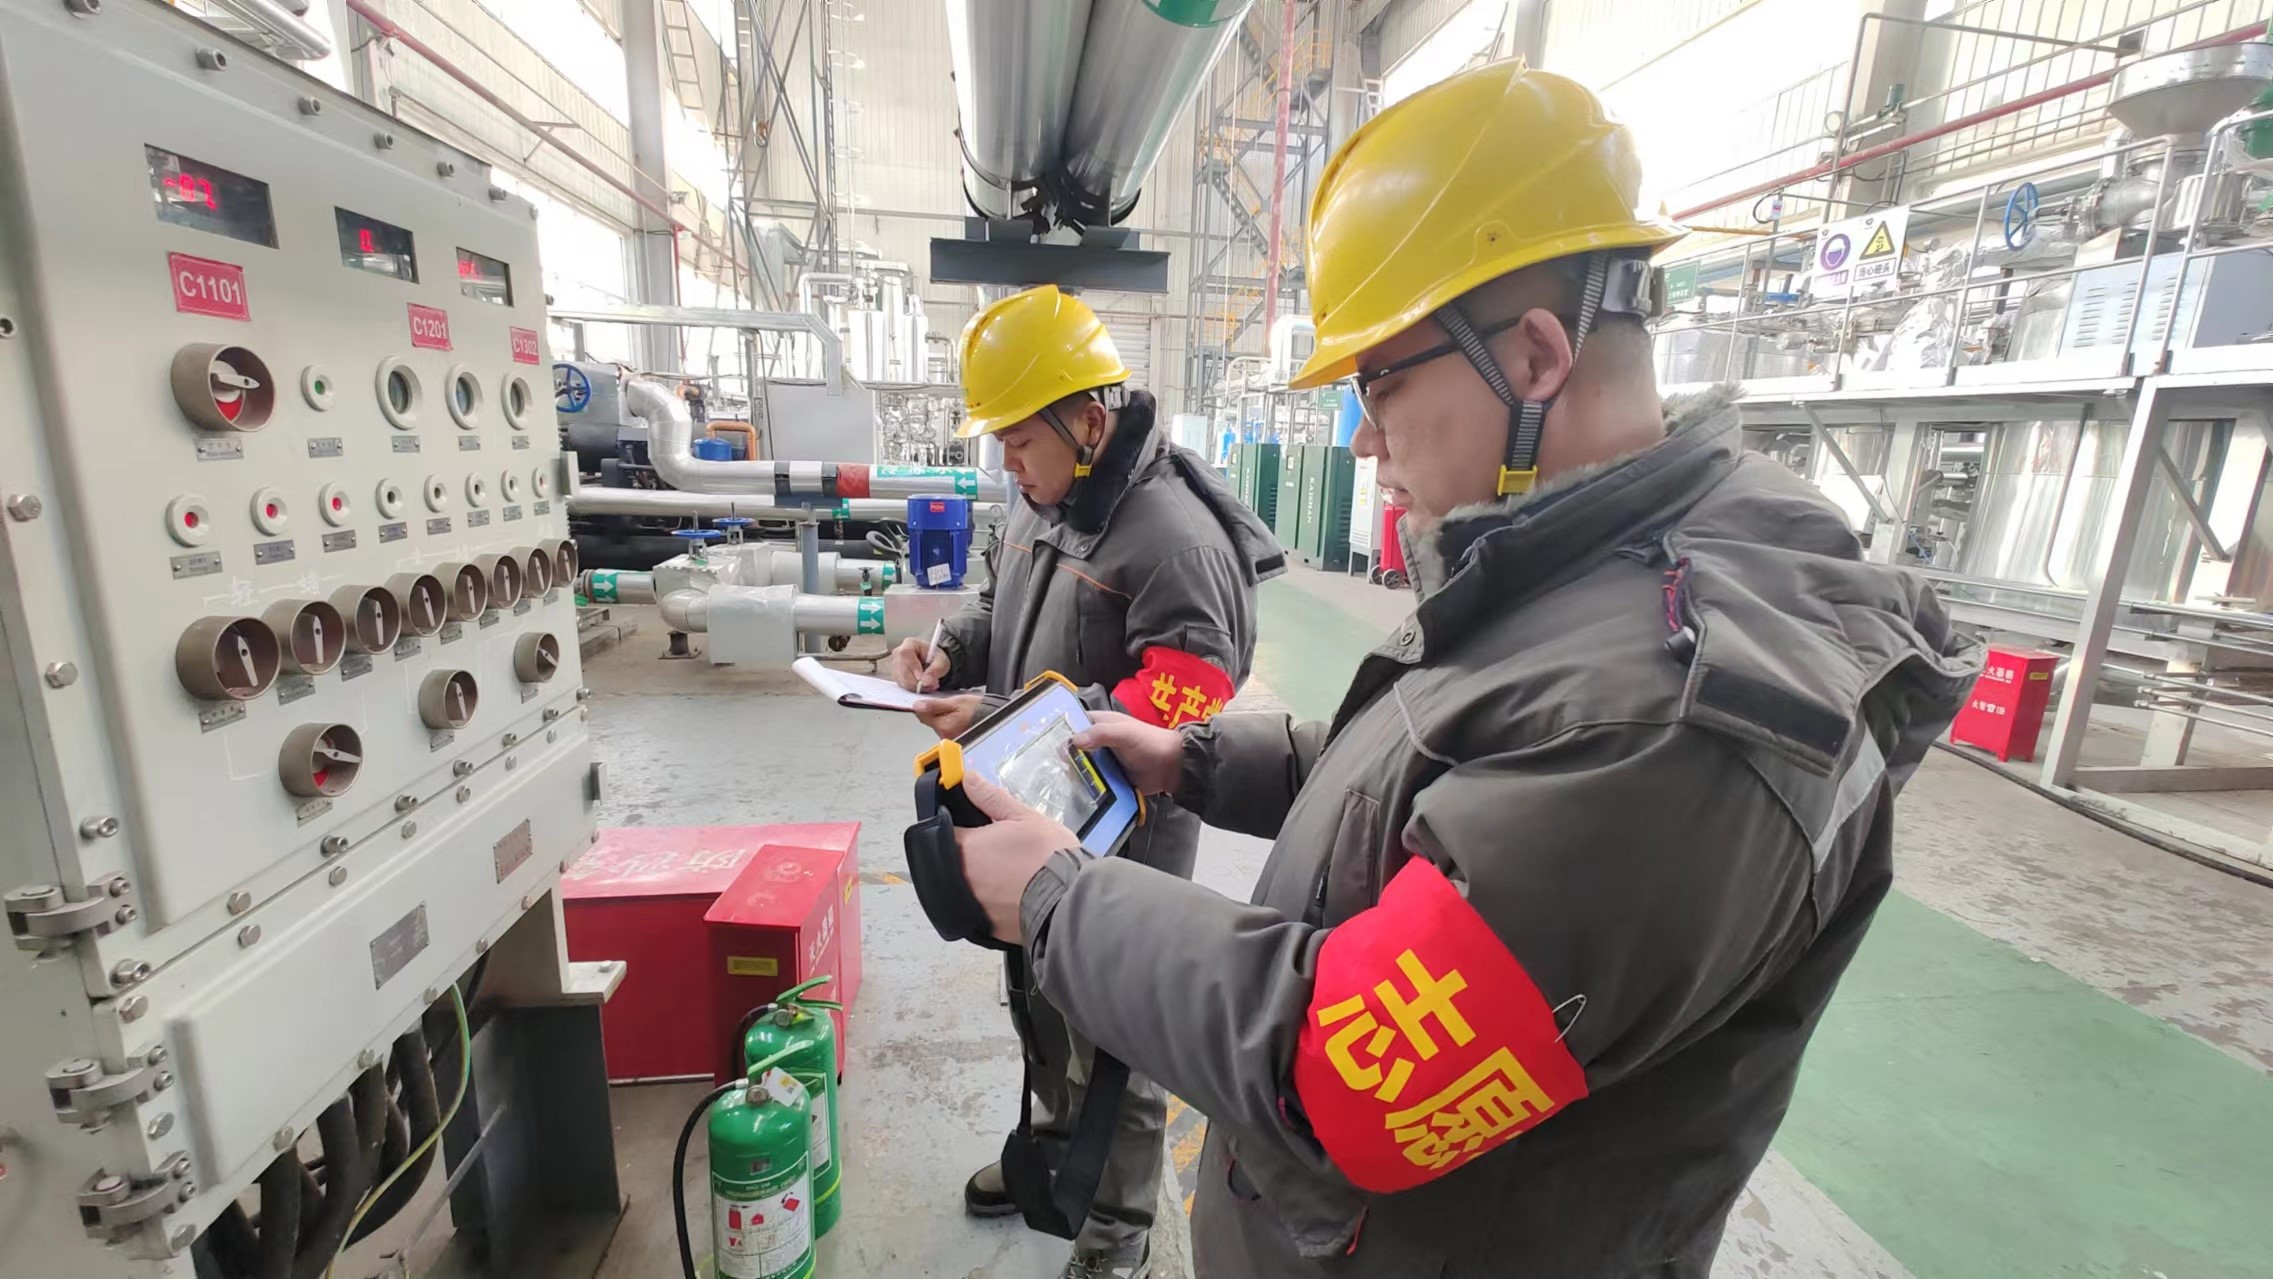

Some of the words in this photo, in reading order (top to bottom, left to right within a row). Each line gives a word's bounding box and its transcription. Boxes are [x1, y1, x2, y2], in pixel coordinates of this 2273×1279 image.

[179, 271, 242, 305] C1101
[413, 317, 448, 339] C1201
[513, 337, 538, 355] C1302
[1316, 948, 1556, 1170] 志愿
